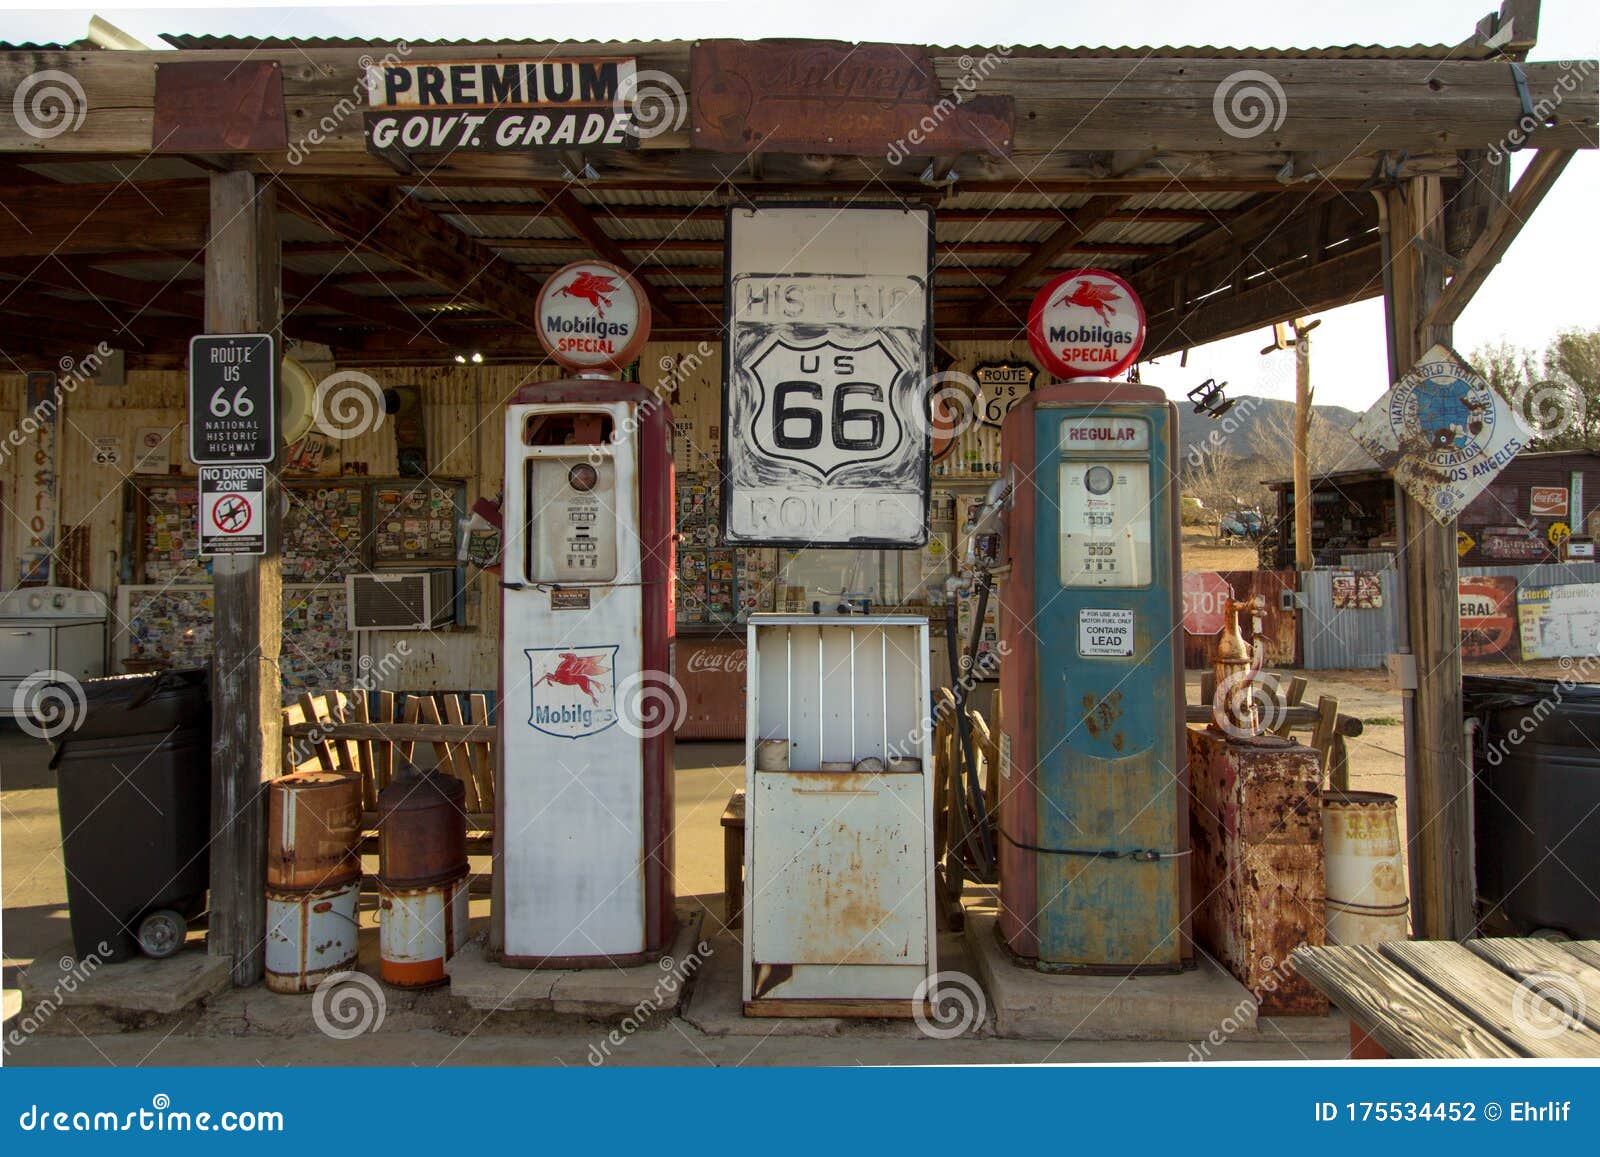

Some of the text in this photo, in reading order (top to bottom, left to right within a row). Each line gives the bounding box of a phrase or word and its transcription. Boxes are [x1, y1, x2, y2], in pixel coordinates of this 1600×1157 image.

[384, 63, 618, 106] PREMIUM
[495, 112, 632, 147] GRADE
[547, 316, 628, 339] Mobilgas
[1049, 325, 1132, 348] Mobilgas
[559, 338, 615, 354] SPECIAL
[210, 347, 252, 363] ROUTE
[1062, 348, 1119, 362] SPECIAL
[223, 365, 240, 382] US
[984, 369, 1026, 381] ROUTE
[210, 385, 254, 418] 66
[1391, 374, 1420, 425] NATIONA
[1422, 364, 1444, 377] OLD
[1449, 364, 1485, 392] TRAILS
[772, 380, 886, 451] 66
[205, 421, 259, 430] NATIONAL
[207, 432, 257, 441] HISTORIC
[1069, 427, 1135, 441] REGULAR
[209, 443, 255, 453] HIGHWAY
[1472, 437, 1522, 478] ANGELES
[203, 468, 263, 481] NO DRONE
[215, 480, 249, 491] ZONE
[1086, 626, 1128, 635] CONTAINS
[1091, 636, 1122, 646] LEAD
